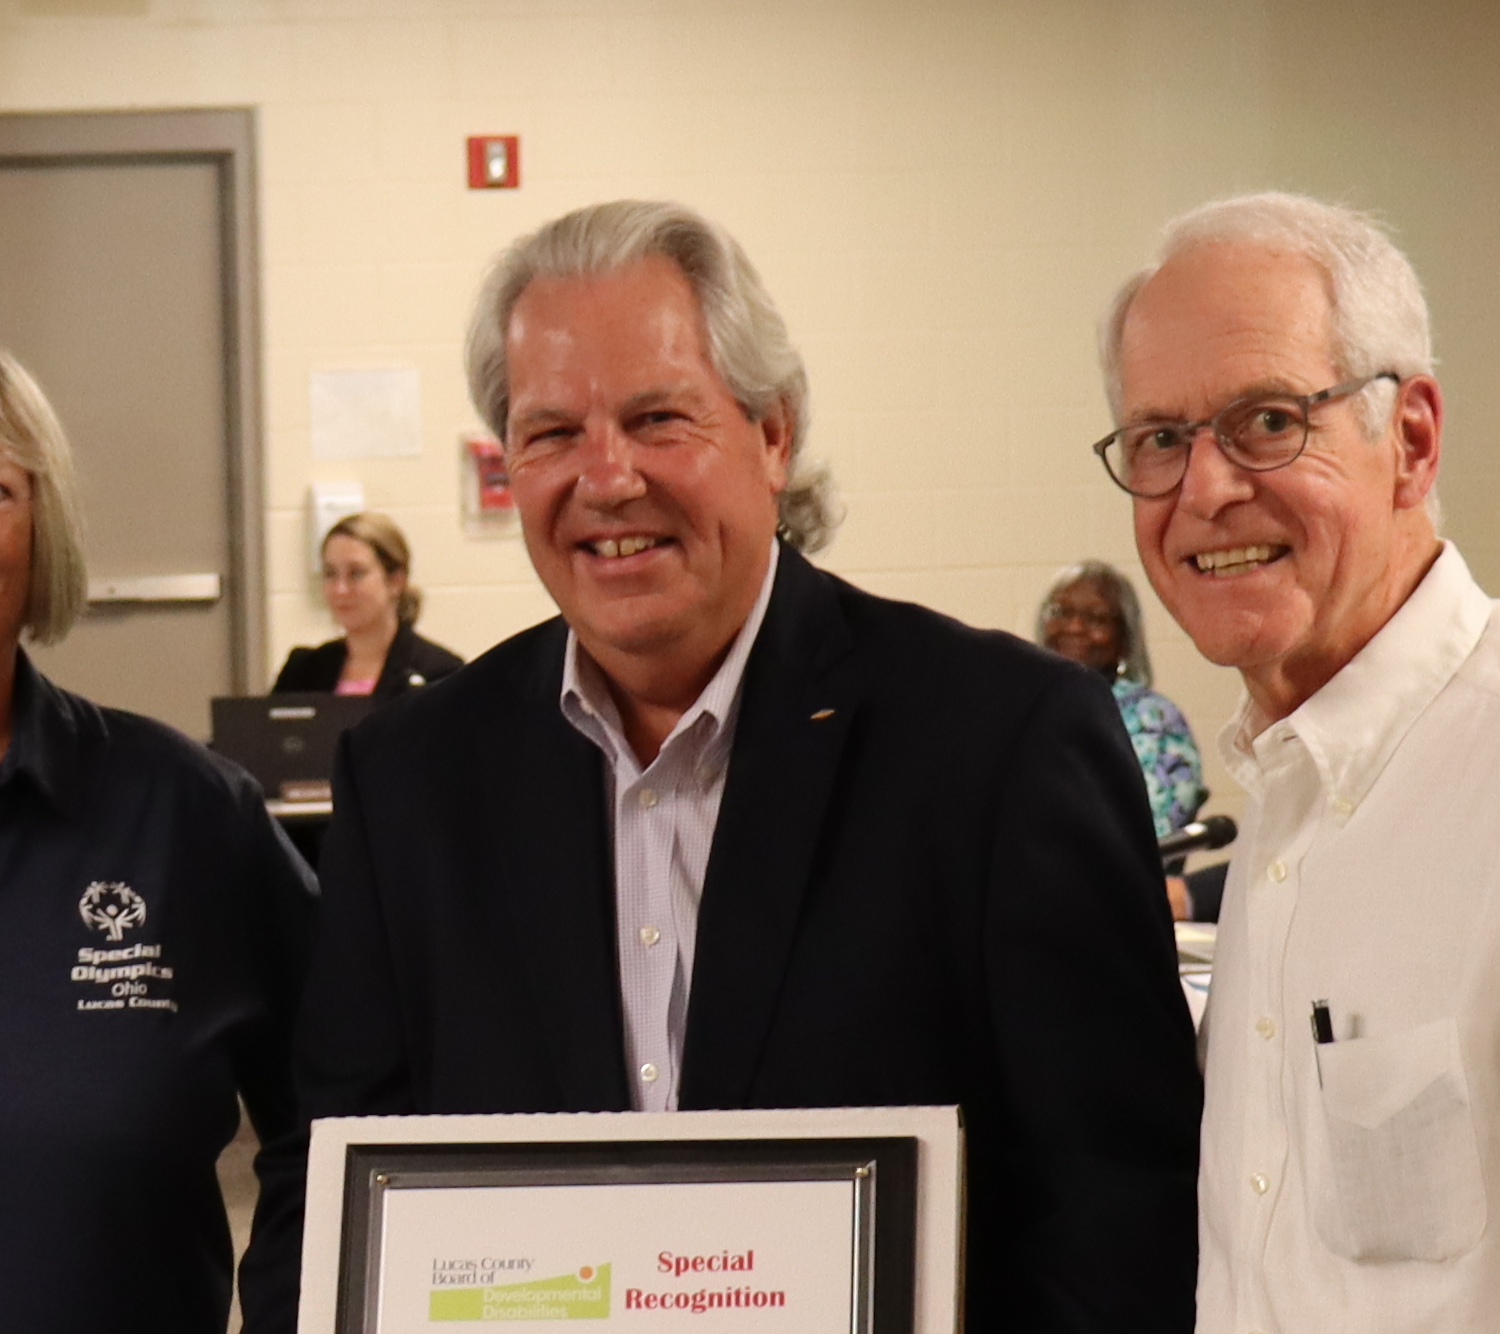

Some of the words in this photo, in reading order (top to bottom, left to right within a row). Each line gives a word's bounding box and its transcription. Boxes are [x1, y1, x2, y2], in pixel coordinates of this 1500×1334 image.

[77, 944, 162, 965] Special
[71, 962, 174, 983] Olympics
[111, 981, 148, 997] Ohio
[432, 1258, 478, 1270] Lucas
[481, 1257, 535, 1273] County
[657, 1250, 754, 1276] Special
[432, 1271, 477, 1285] Board
[480, 1271, 497, 1284] of
[483, 1287, 602, 1304] Developmental
[625, 1284, 786, 1314] Recognition
[482, 1304, 569, 1320] Disabilities
